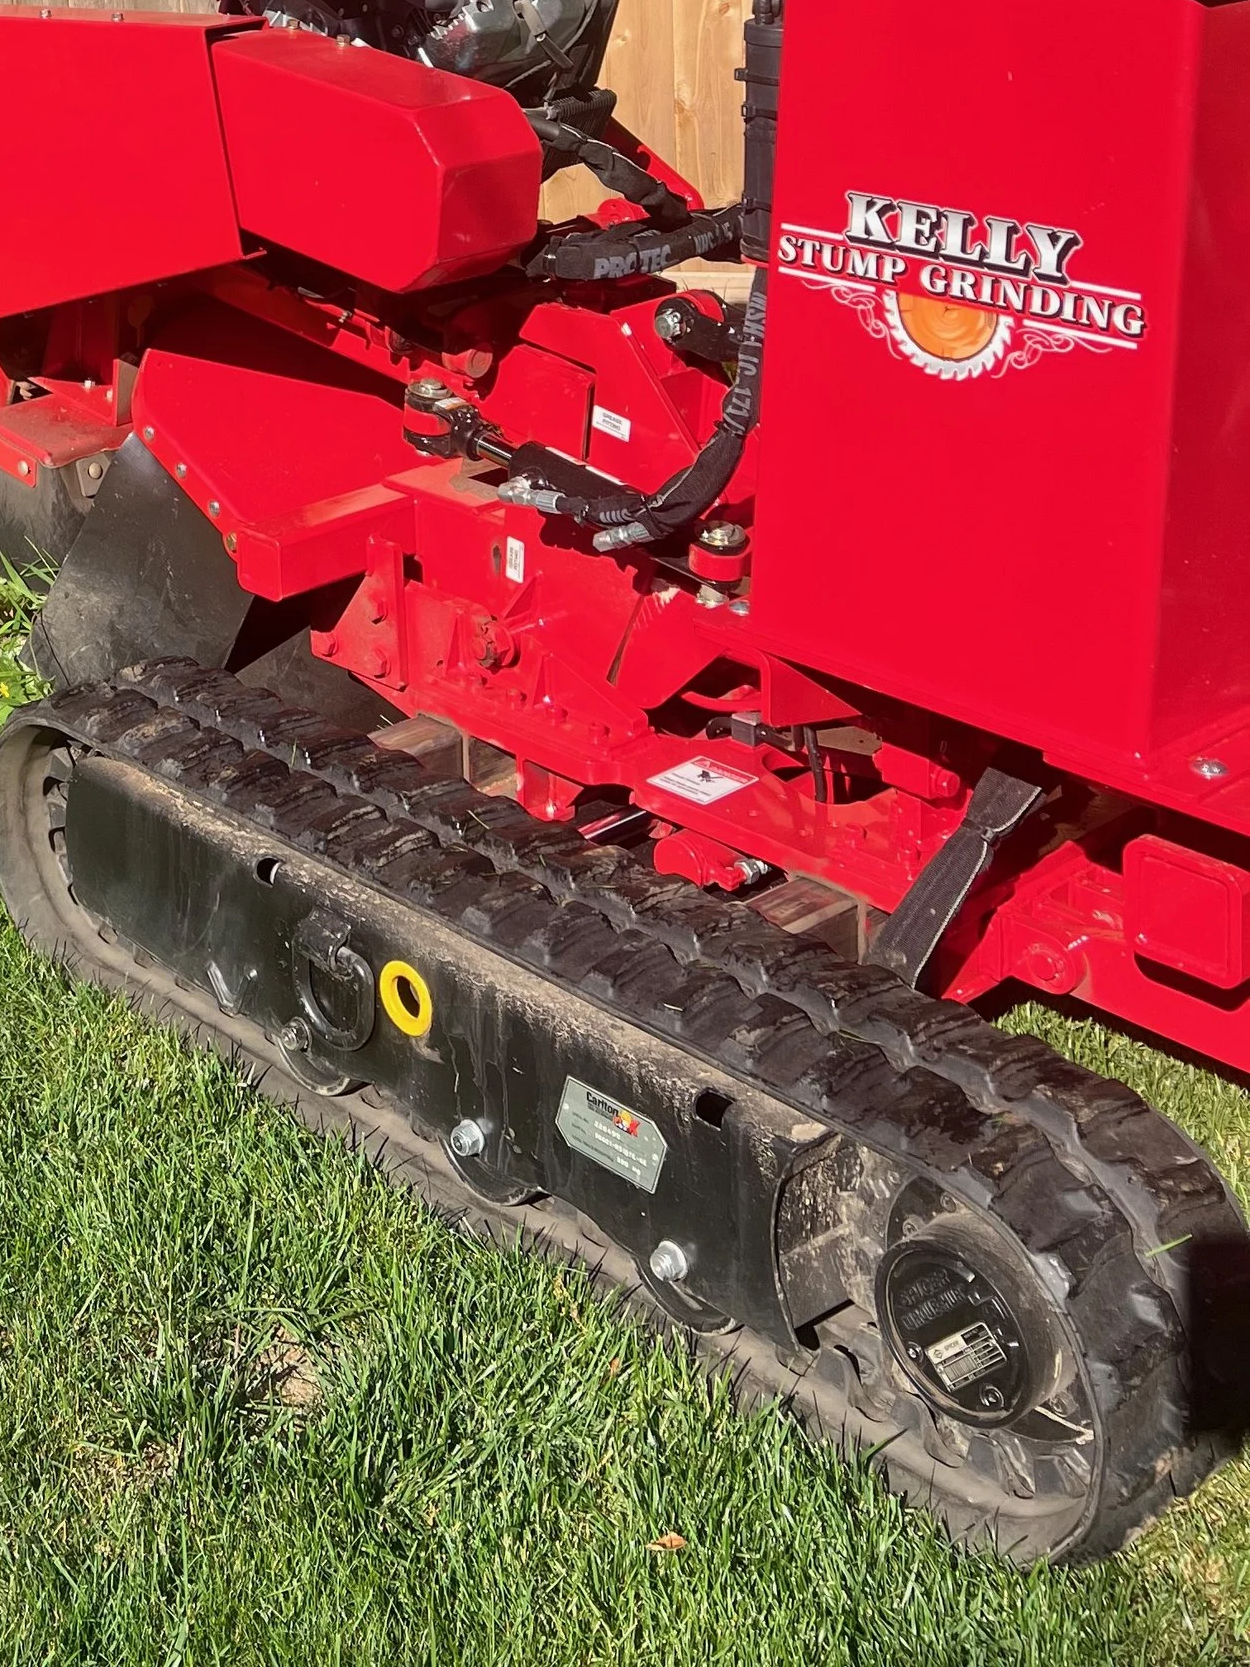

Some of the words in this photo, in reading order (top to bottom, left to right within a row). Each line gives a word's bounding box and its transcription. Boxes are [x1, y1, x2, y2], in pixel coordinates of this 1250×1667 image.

[845, 191, 1083, 285] KELLY
[777, 234, 908, 284] STUMP
[919, 262, 1146, 337] GRINDING
[586, 1091, 618, 1117] Carlton
